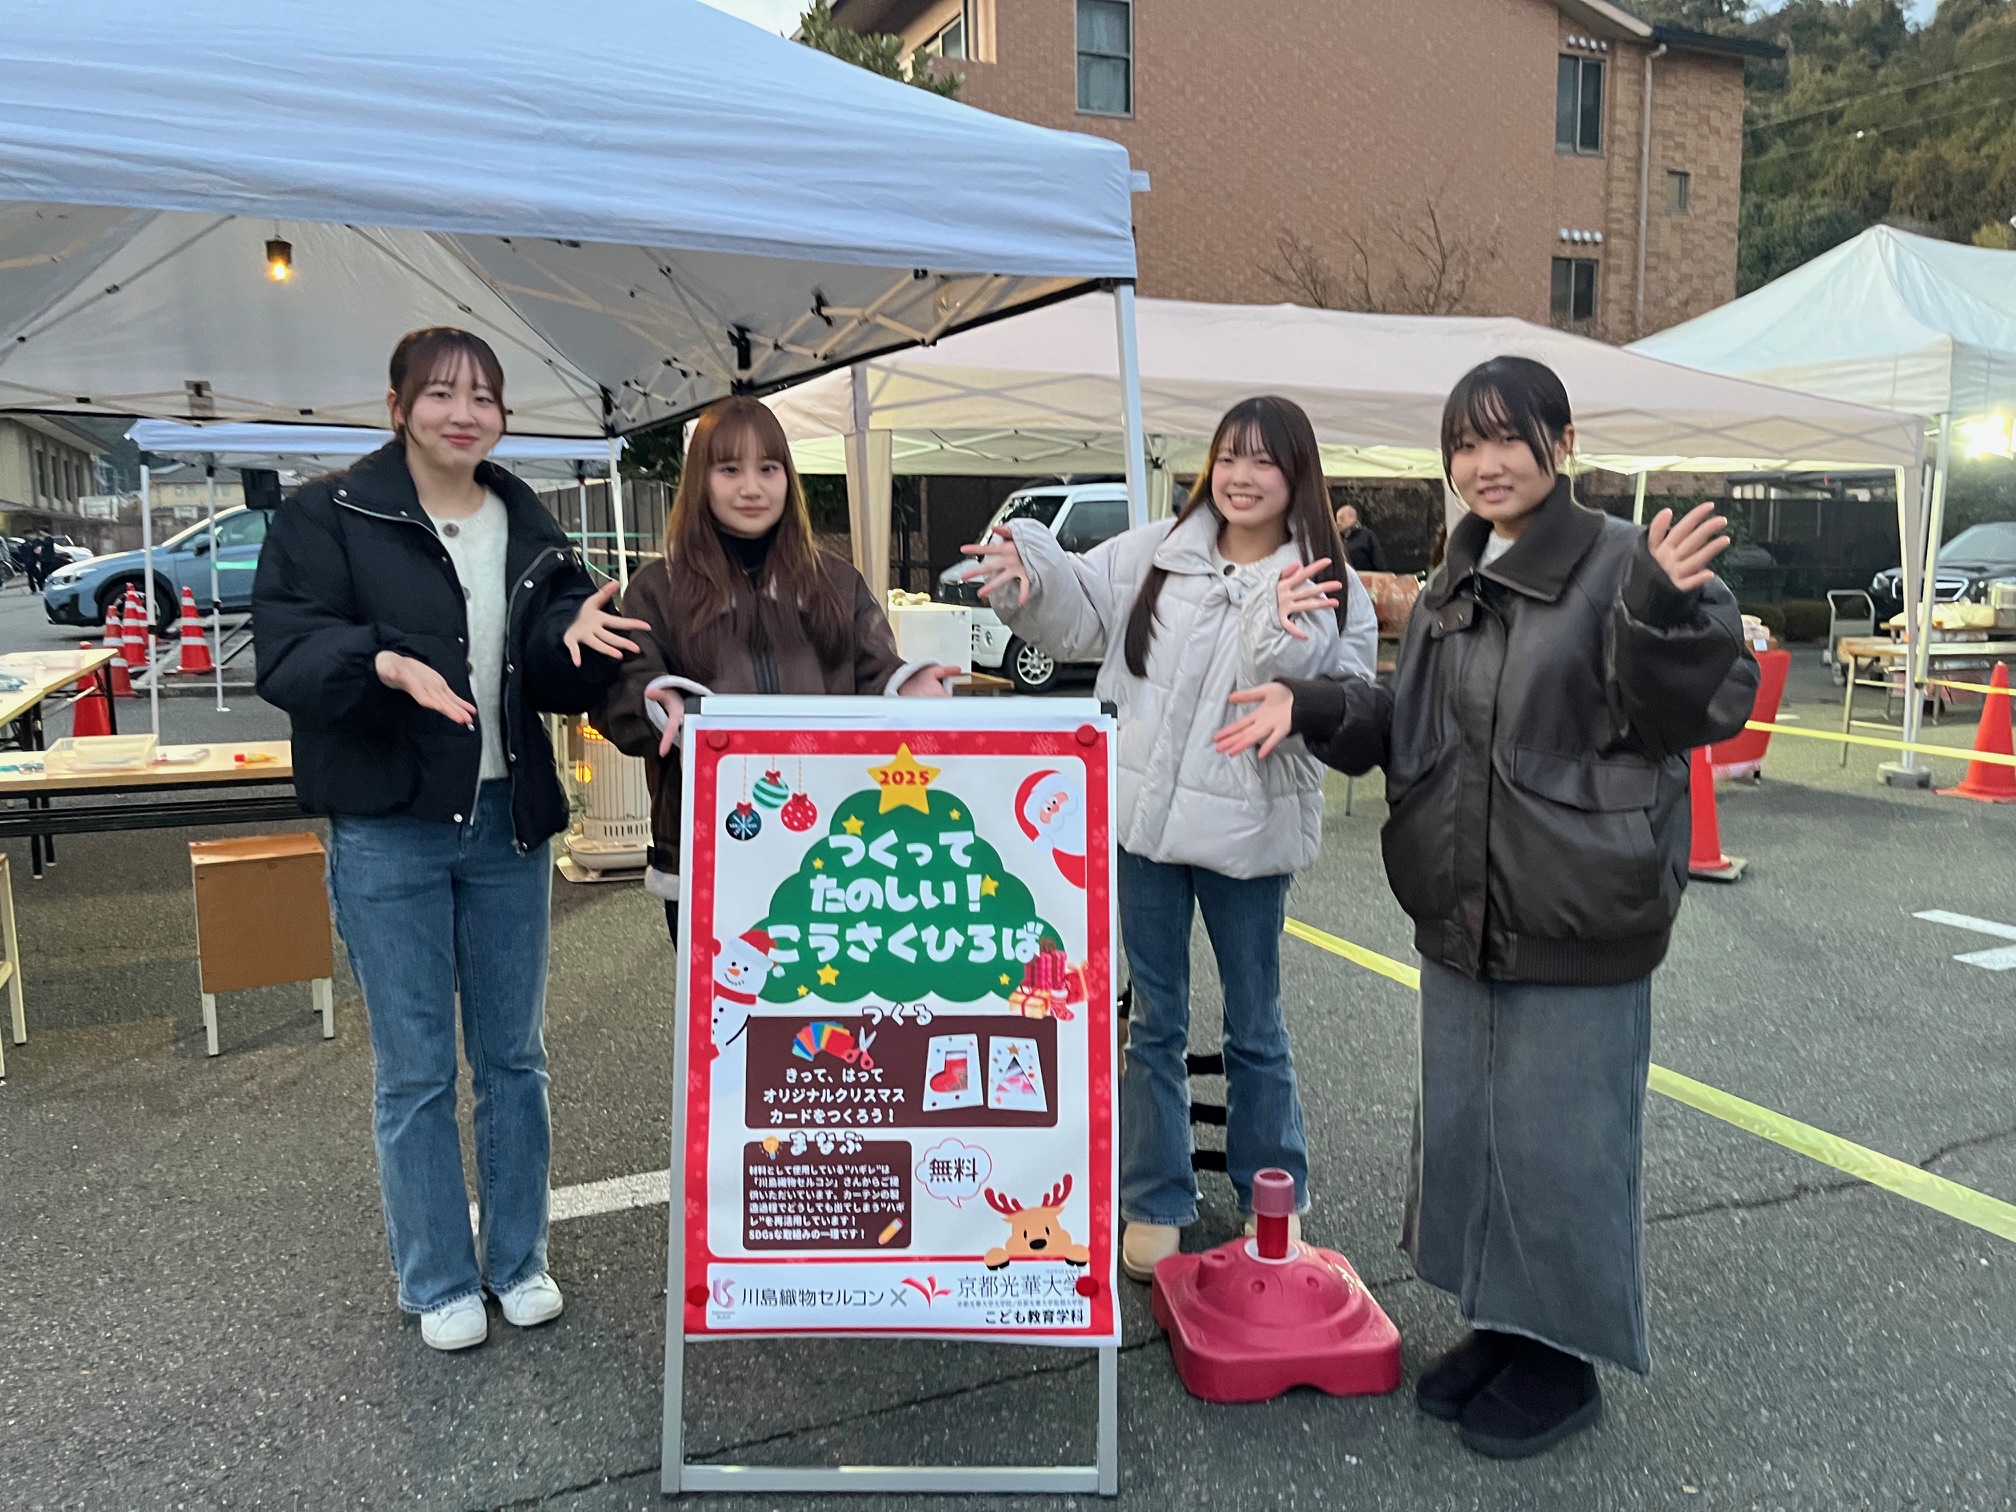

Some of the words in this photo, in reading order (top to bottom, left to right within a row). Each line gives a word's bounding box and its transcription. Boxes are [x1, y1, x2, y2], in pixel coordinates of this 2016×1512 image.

[879, 770, 930, 786] 2025
[829, 830, 976, 869] つくって
[810, 874, 982, 913] たのしい！
[767, 920, 1045, 964] こうさくひろば
[862, 1003, 933, 1026] つくる
[763, 1088, 905, 1104] オリジナルクリスマス
[770, 1109, 895, 1125] カードをつくろう！
[789, 1131, 864, 1156] まなぶ
[929, 1157, 979, 1184] 無料
[742, 1288, 884, 1308] 川島織物セルコン
[985, 1308, 1084, 1325] こども教育学科
